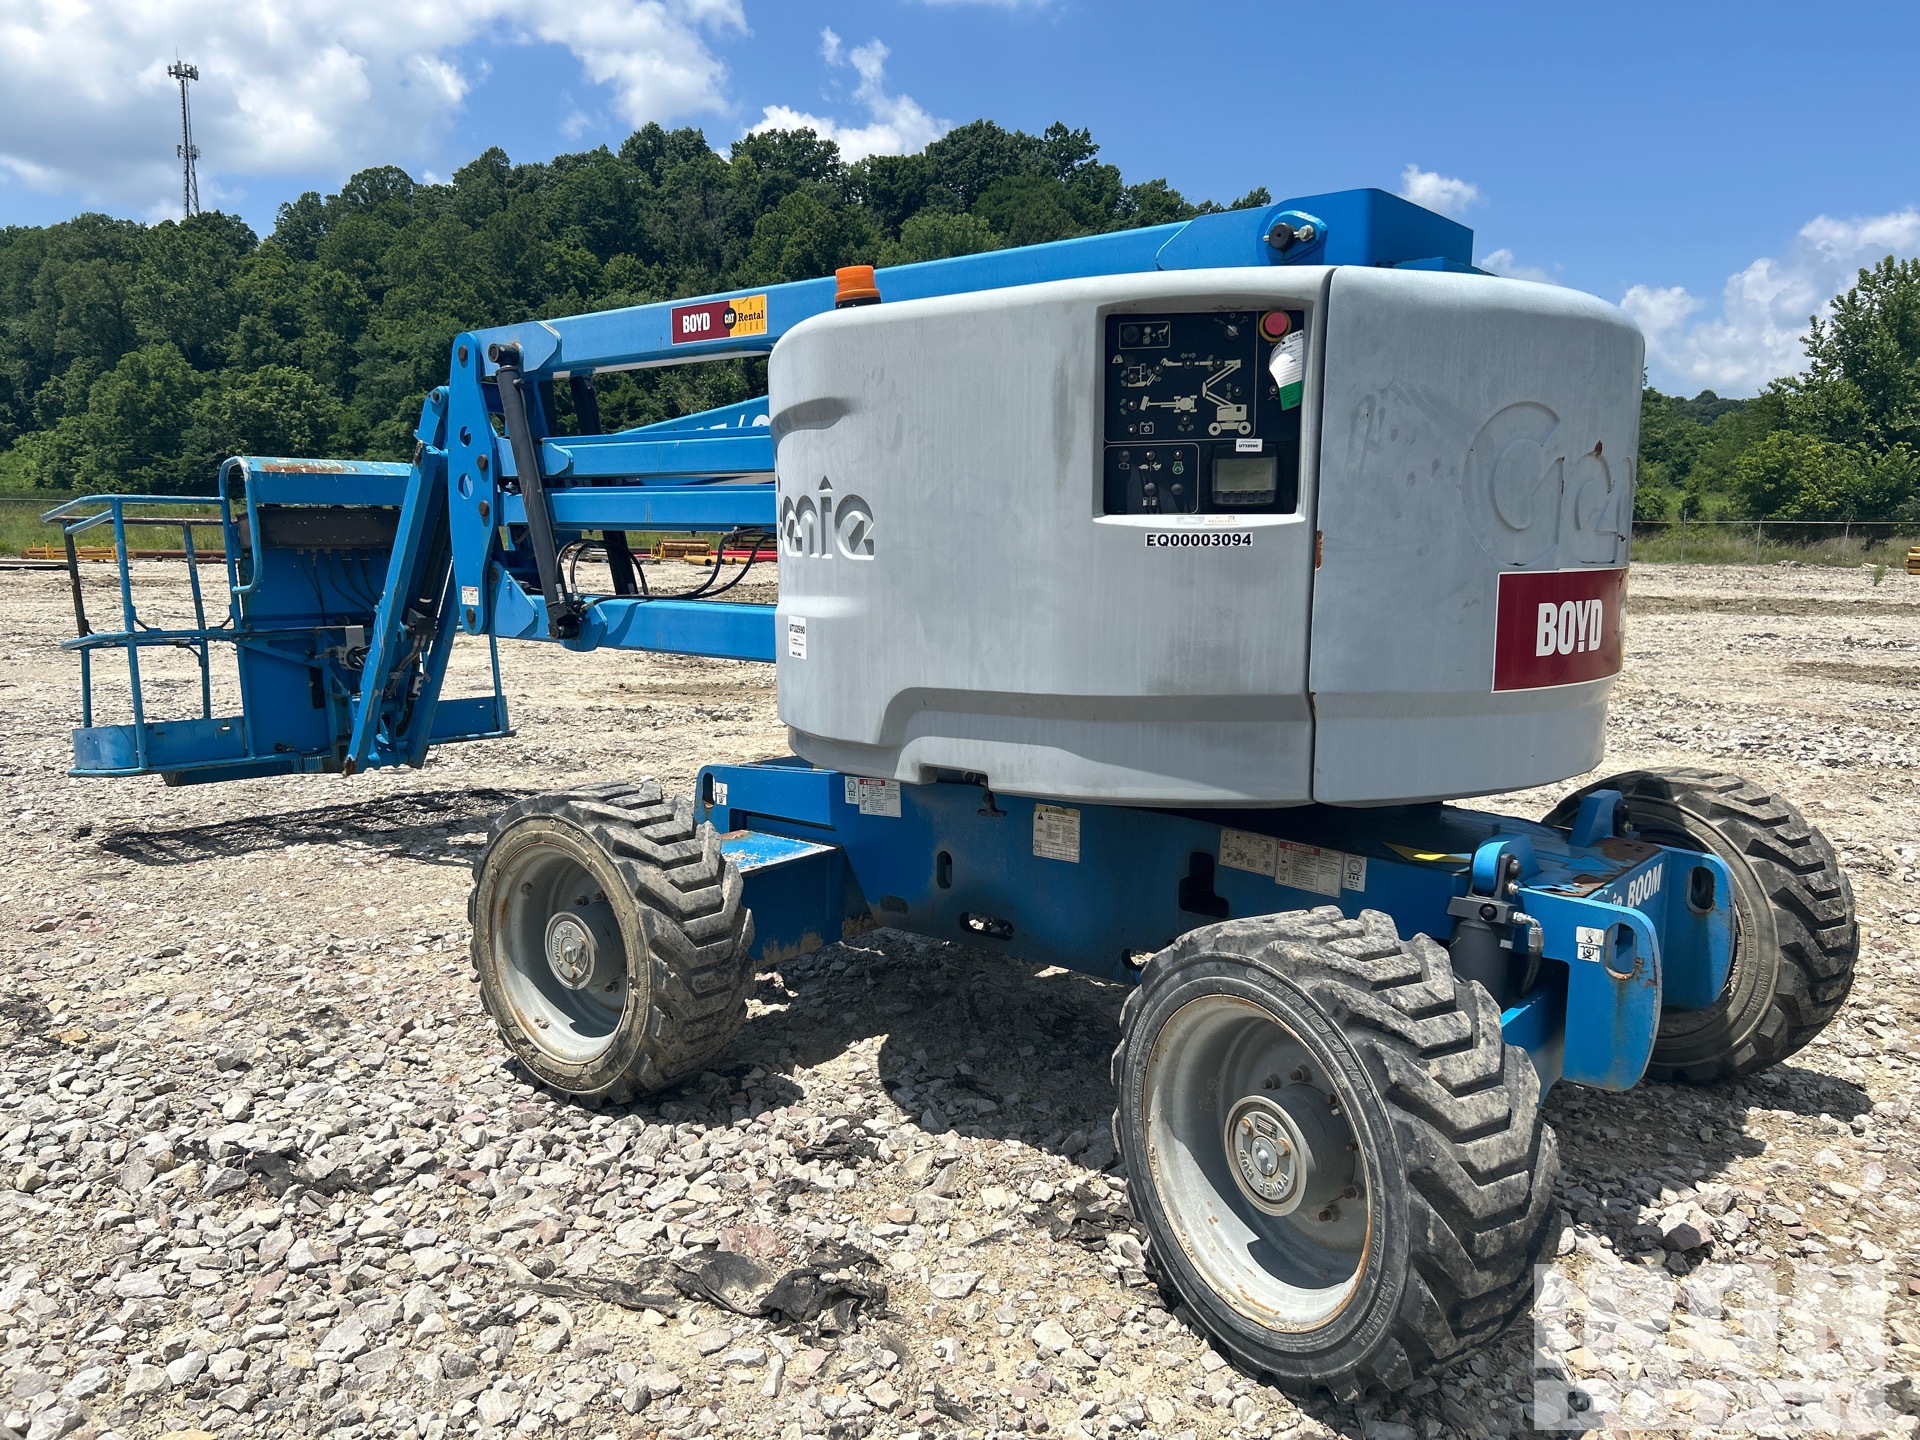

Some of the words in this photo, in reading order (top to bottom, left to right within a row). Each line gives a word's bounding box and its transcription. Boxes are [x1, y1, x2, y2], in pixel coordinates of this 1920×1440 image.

[682, 312, 711, 334] BOYD
[724, 313, 735, 325] CAT
[738, 310, 764, 322] Rental
[778, 475, 875, 561] enie
[1146, 533, 1252, 547] EQ00003094
[1535, 599, 1603, 657] BOYD
[1627, 862, 1663, 908] BOOM
[1245, 967, 1368, 1092] OUTRIGGER
[1133, 1072, 1141, 1104] GUARD
[1240, 1150, 1255, 1181] HUB
[1259, 1173, 1290, 1198] POWER
